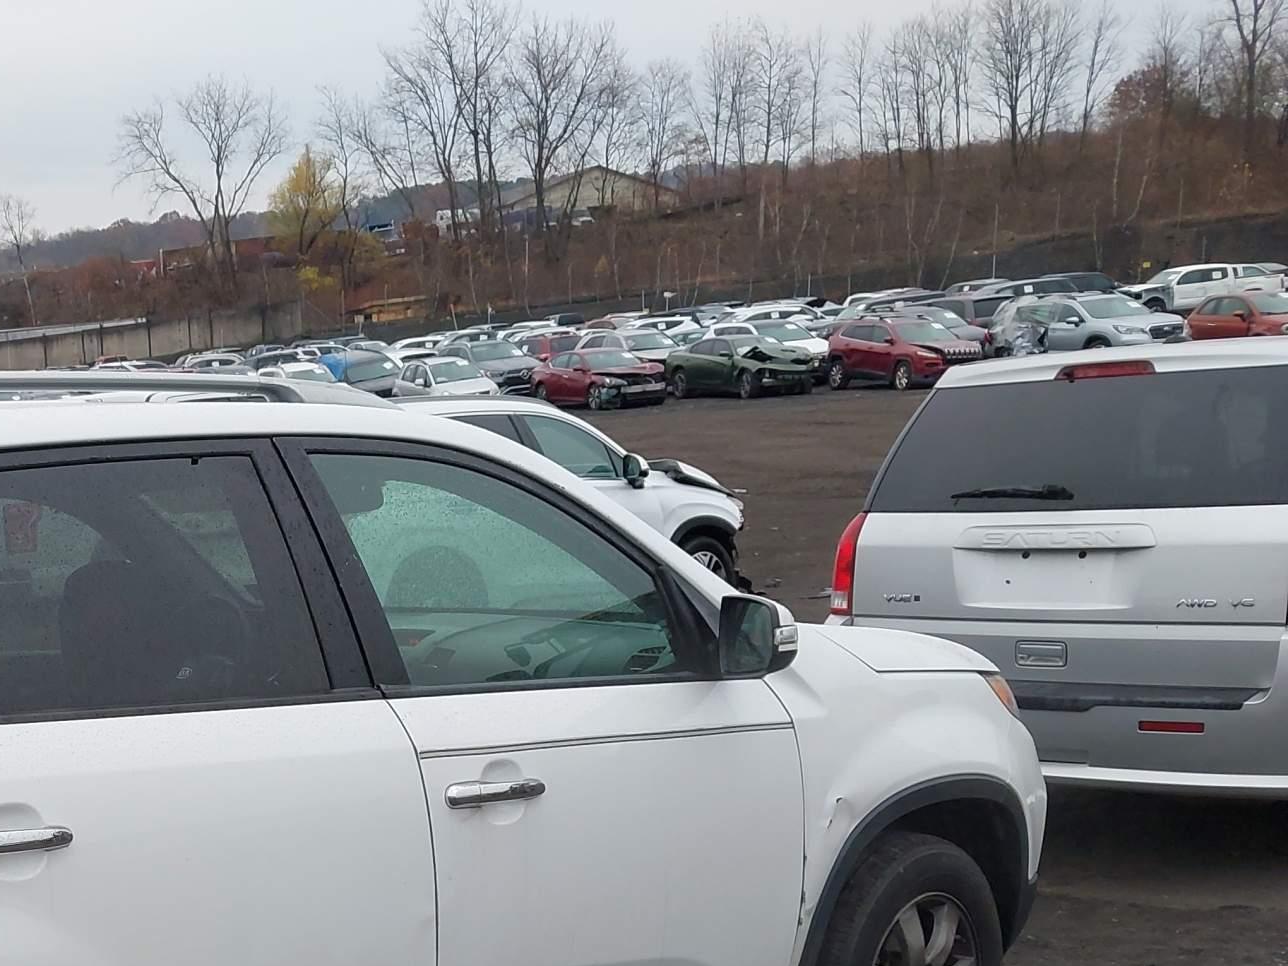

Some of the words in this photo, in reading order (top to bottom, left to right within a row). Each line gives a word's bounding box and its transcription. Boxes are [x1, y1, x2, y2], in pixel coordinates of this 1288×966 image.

[982, 531, 1121, 548] SATURN
[883, 593, 911, 603] VUE
[1176, 598, 1217, 608] AWD
